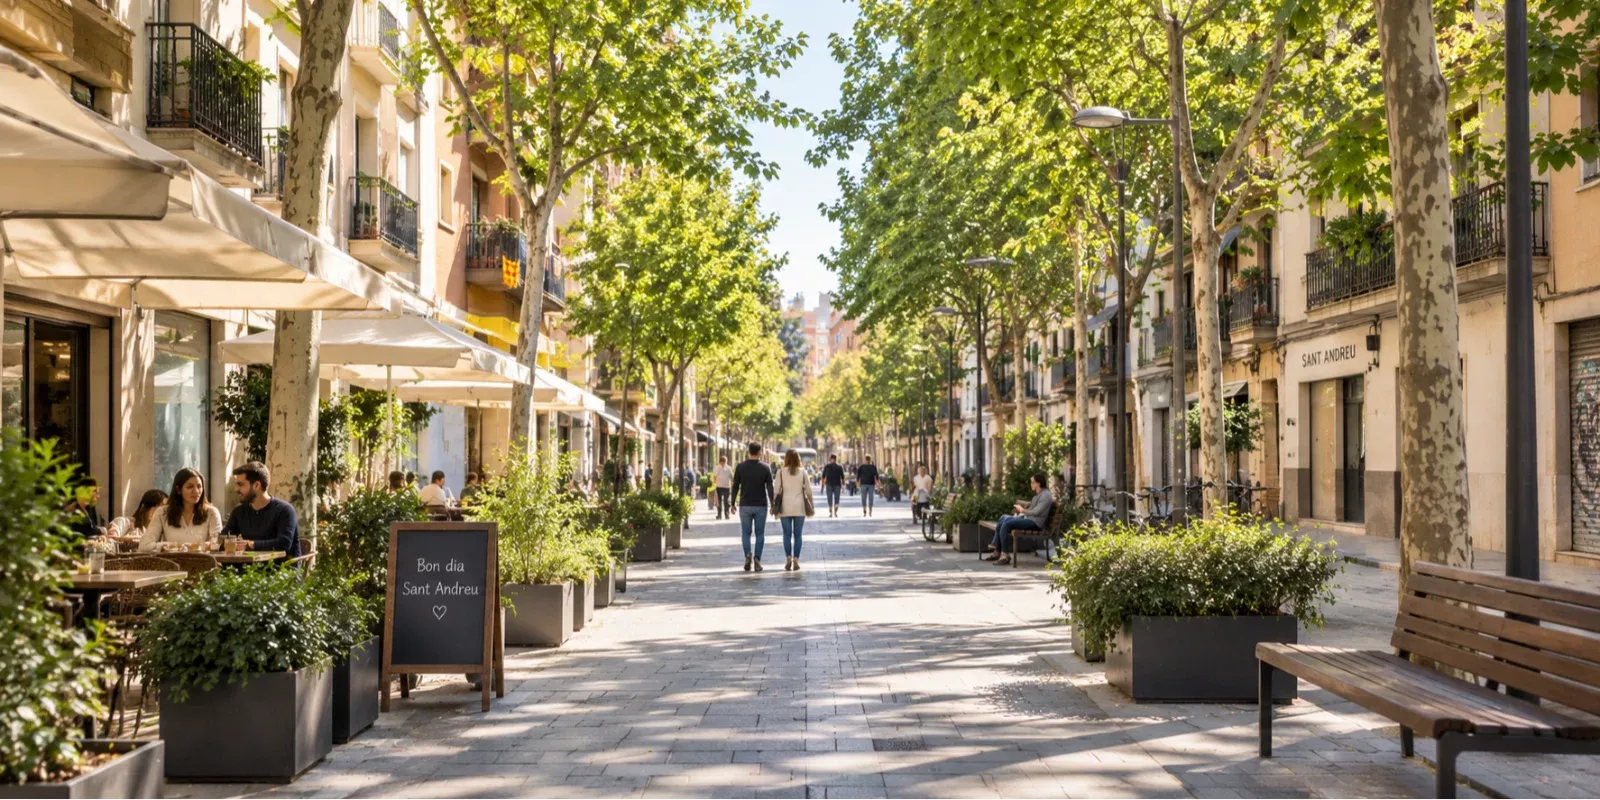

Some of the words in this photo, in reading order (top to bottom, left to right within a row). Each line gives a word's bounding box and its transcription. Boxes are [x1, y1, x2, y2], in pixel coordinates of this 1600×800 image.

[1302, 351, 1321, 368] SANT
[1324, 344, 1356, 362] ANDREU
[417, 558, 440, 572] Bon
[445, 558, 465, 572] dia
[402, 581, 430, 595] Sant
[435, 581, 479, 595] Andreu
